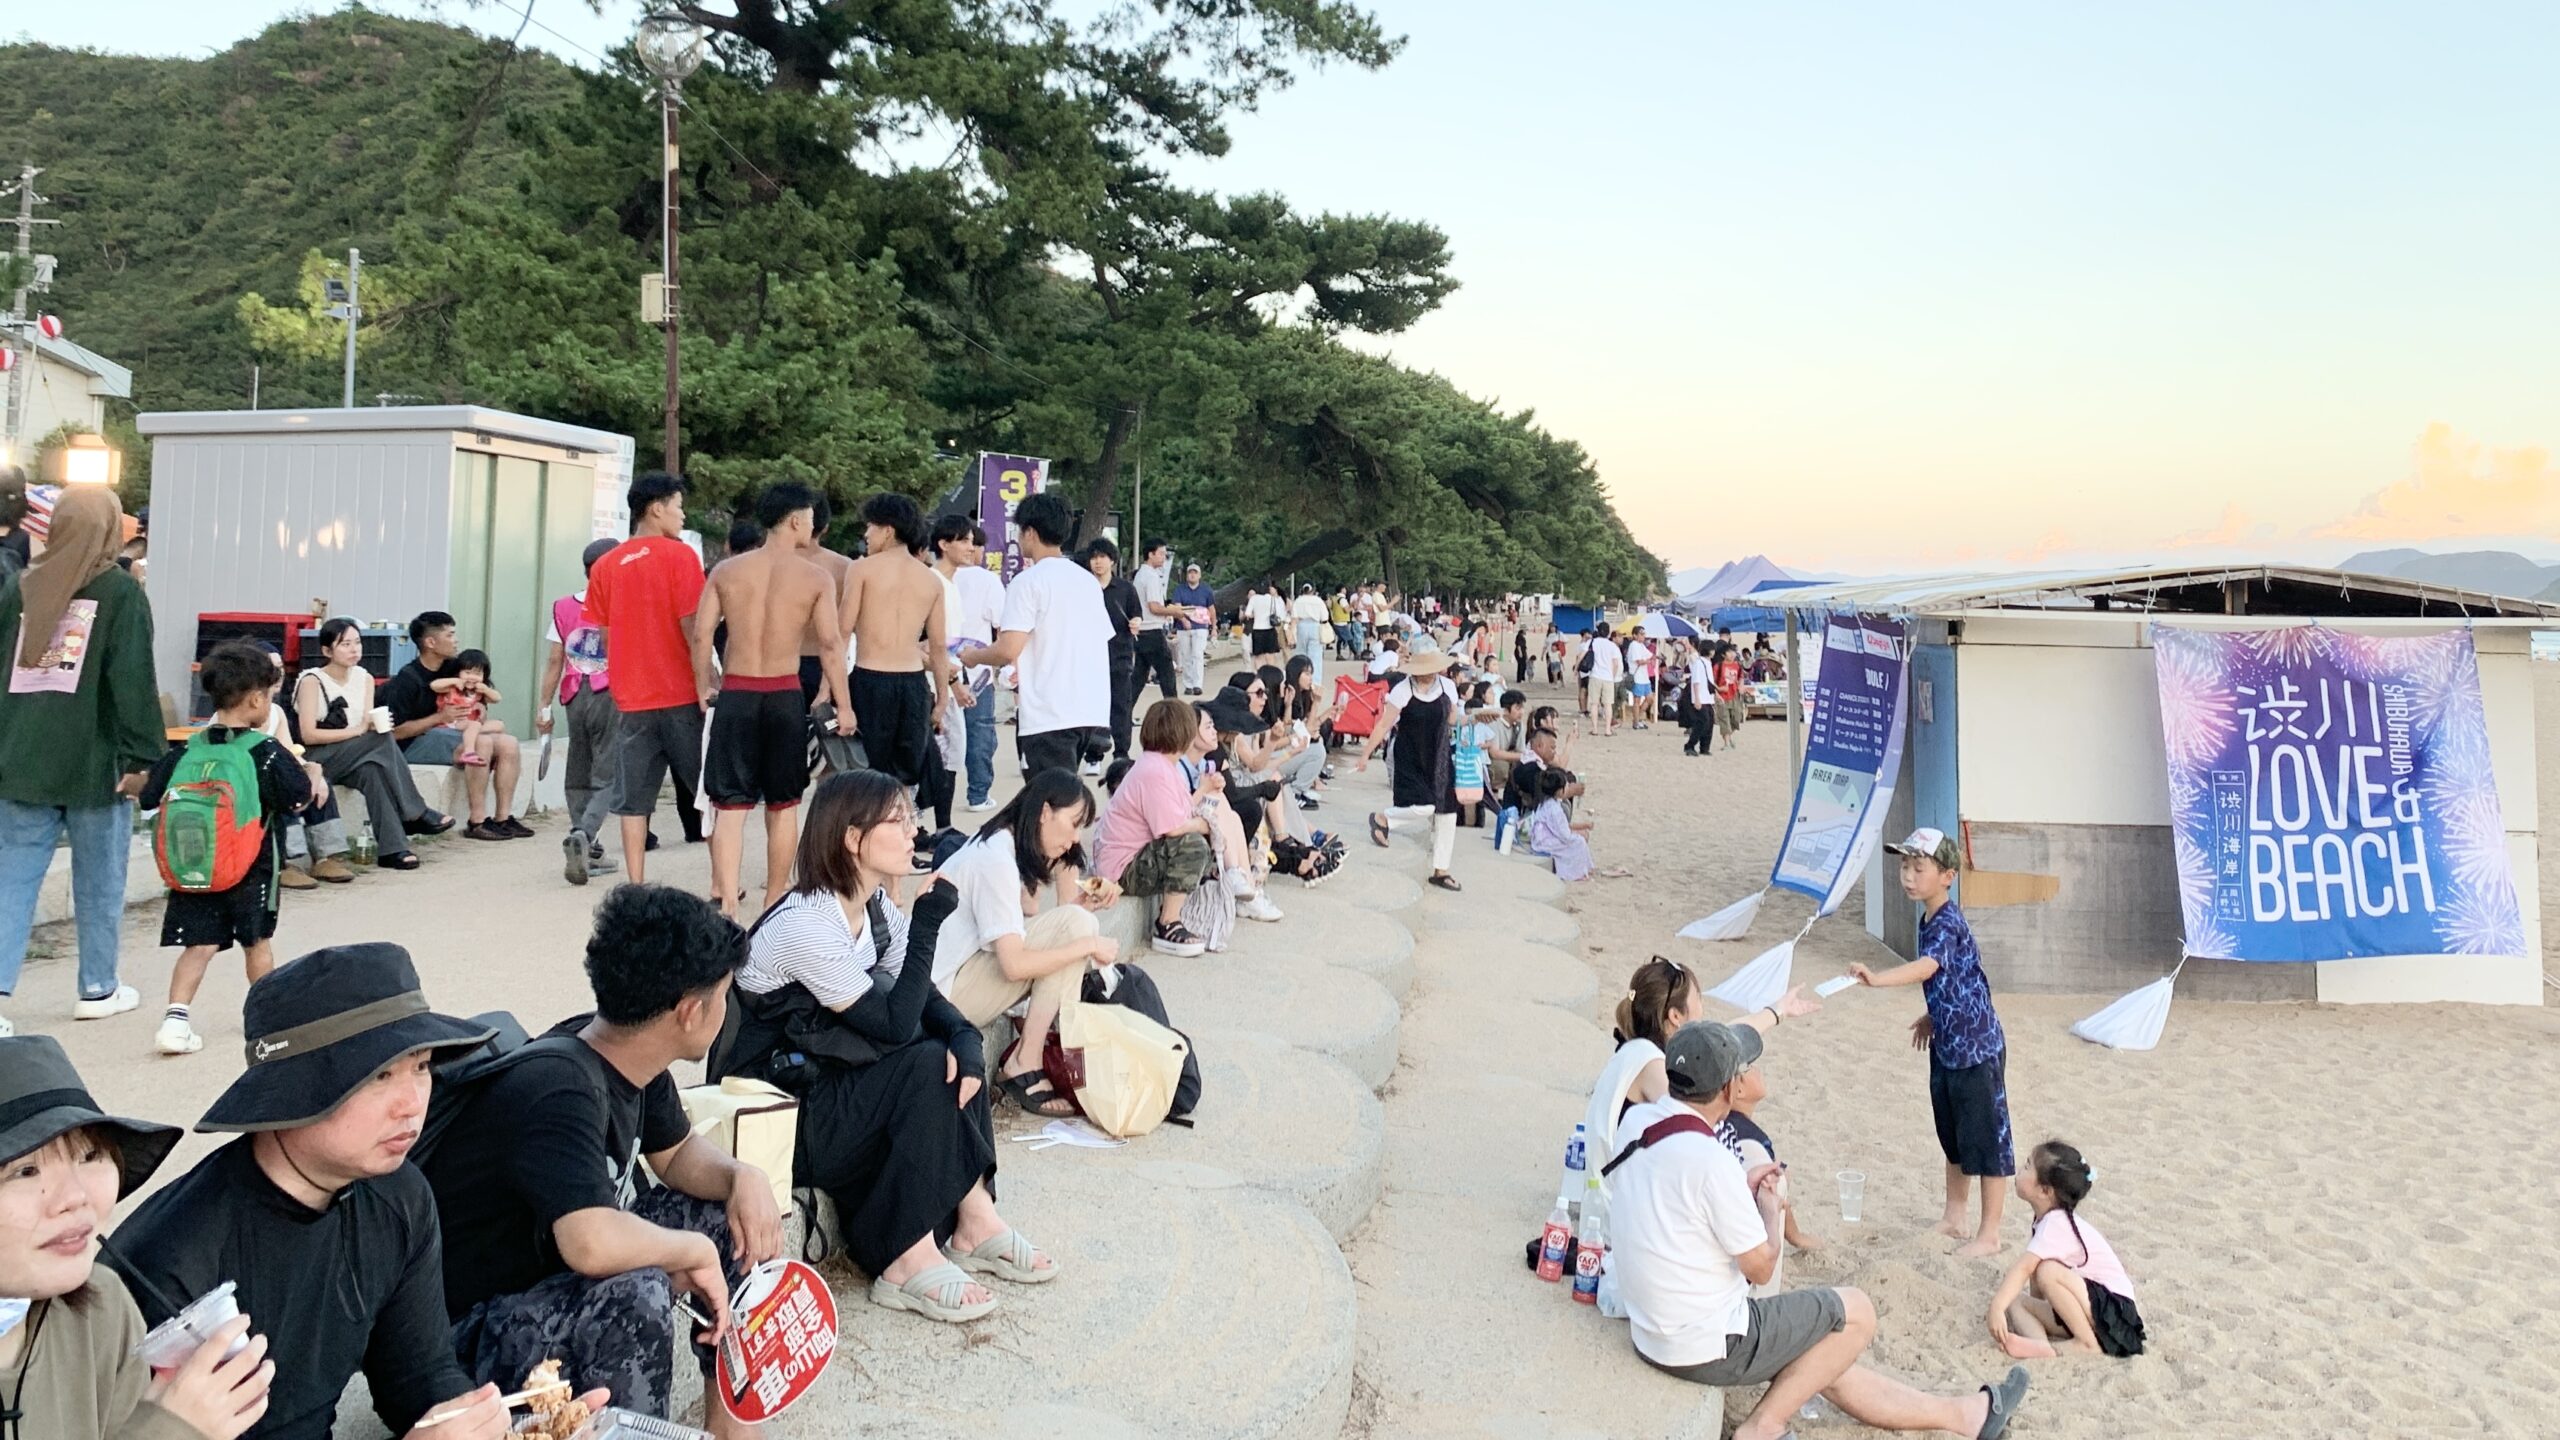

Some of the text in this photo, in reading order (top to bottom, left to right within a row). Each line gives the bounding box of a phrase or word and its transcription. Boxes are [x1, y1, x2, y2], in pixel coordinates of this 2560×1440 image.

[2237, 675, 2382, 742] 渋川
[1811, 768, 1832, 784] AREA
[2248, 744, 2392, 831] LOVE
[2382, 684, 2422, 823] SHIBUKAWA &
[2220, 791, 2242, 877] 渋川海岸
[2249, 826, 2436, 923] BEACH
[746, 1278, 818, 1360] 買取ます!
[782, 1306, 824, 1357] 全部
[752, 1320, 836, 1416] 岡山の車
